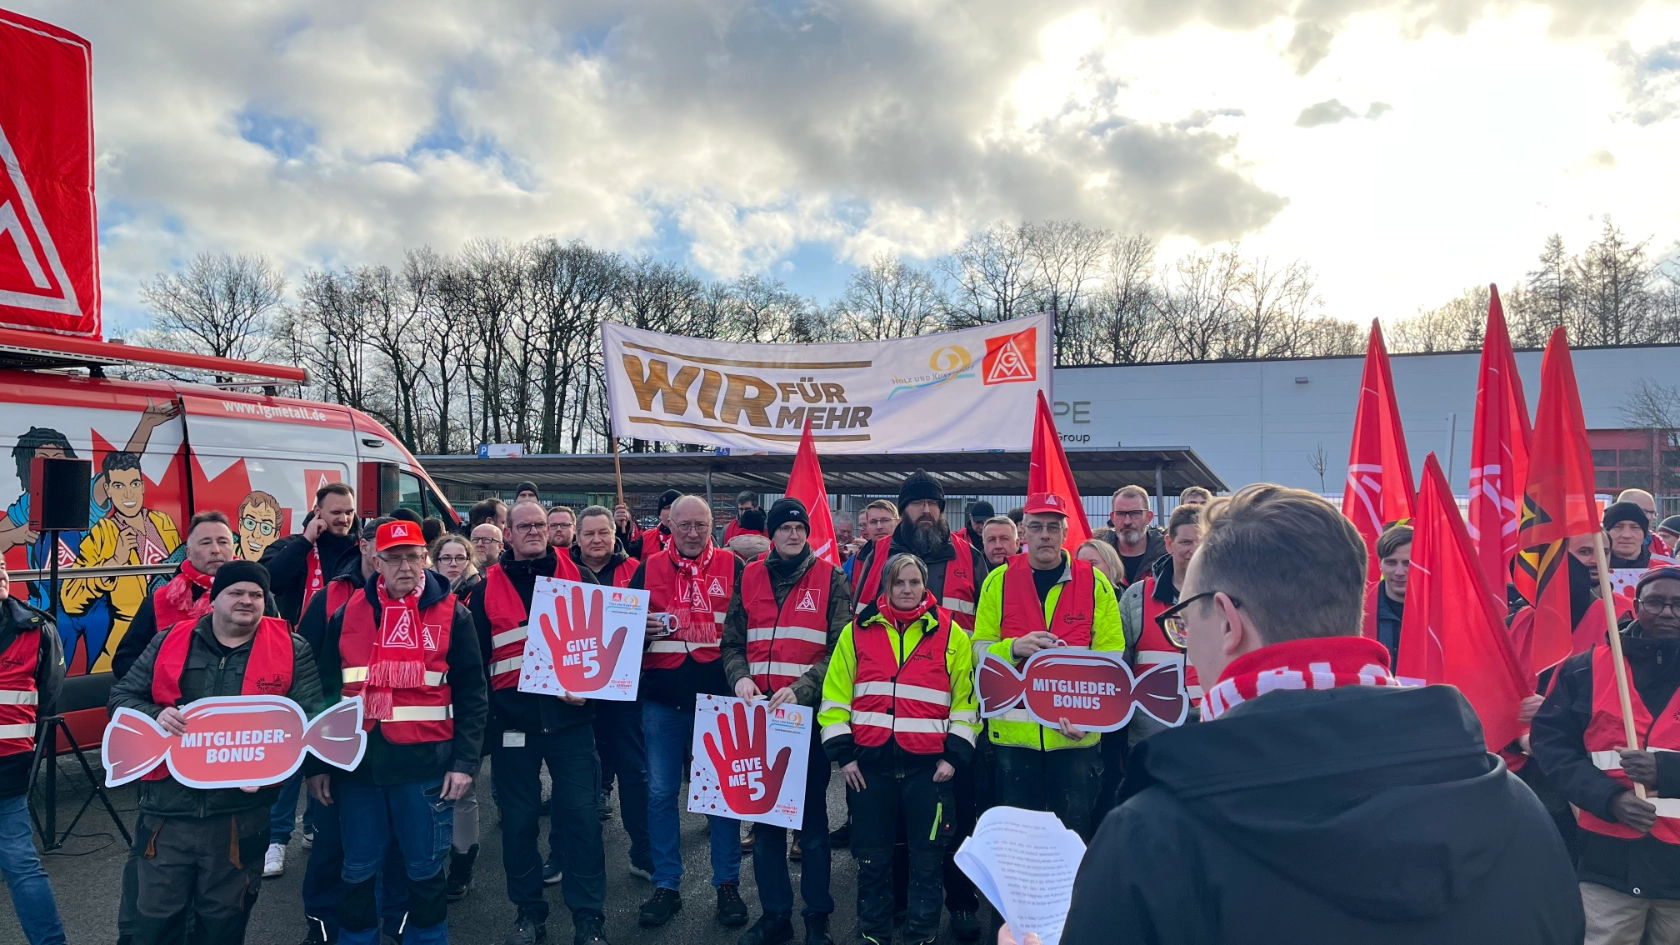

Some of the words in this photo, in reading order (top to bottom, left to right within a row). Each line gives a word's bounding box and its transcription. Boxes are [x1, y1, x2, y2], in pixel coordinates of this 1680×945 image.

[622, 353, 778, 428] WIR
[776, 376, 848, 404] FÜR
[222, 402, 327, 422] www.igmetall.de
[776, 406, 873, 430] MEHR
[566, 637, 598, 653] GIVE
[562, 653, 582, 667] ME
[582, 649, 601, 679] 5
[1032, 677, 1122, 696] MITGLIEDER-
[1053, 694, 1101, 710] BONUS
[180, 728, 292, 748] MITGLIEDER-
[206, 746, 265, 764] BONUS
[731, 756, 763, 773] GIVE
[728, 773, 747, 787] ME
[747, 771, 766, 802] 5
